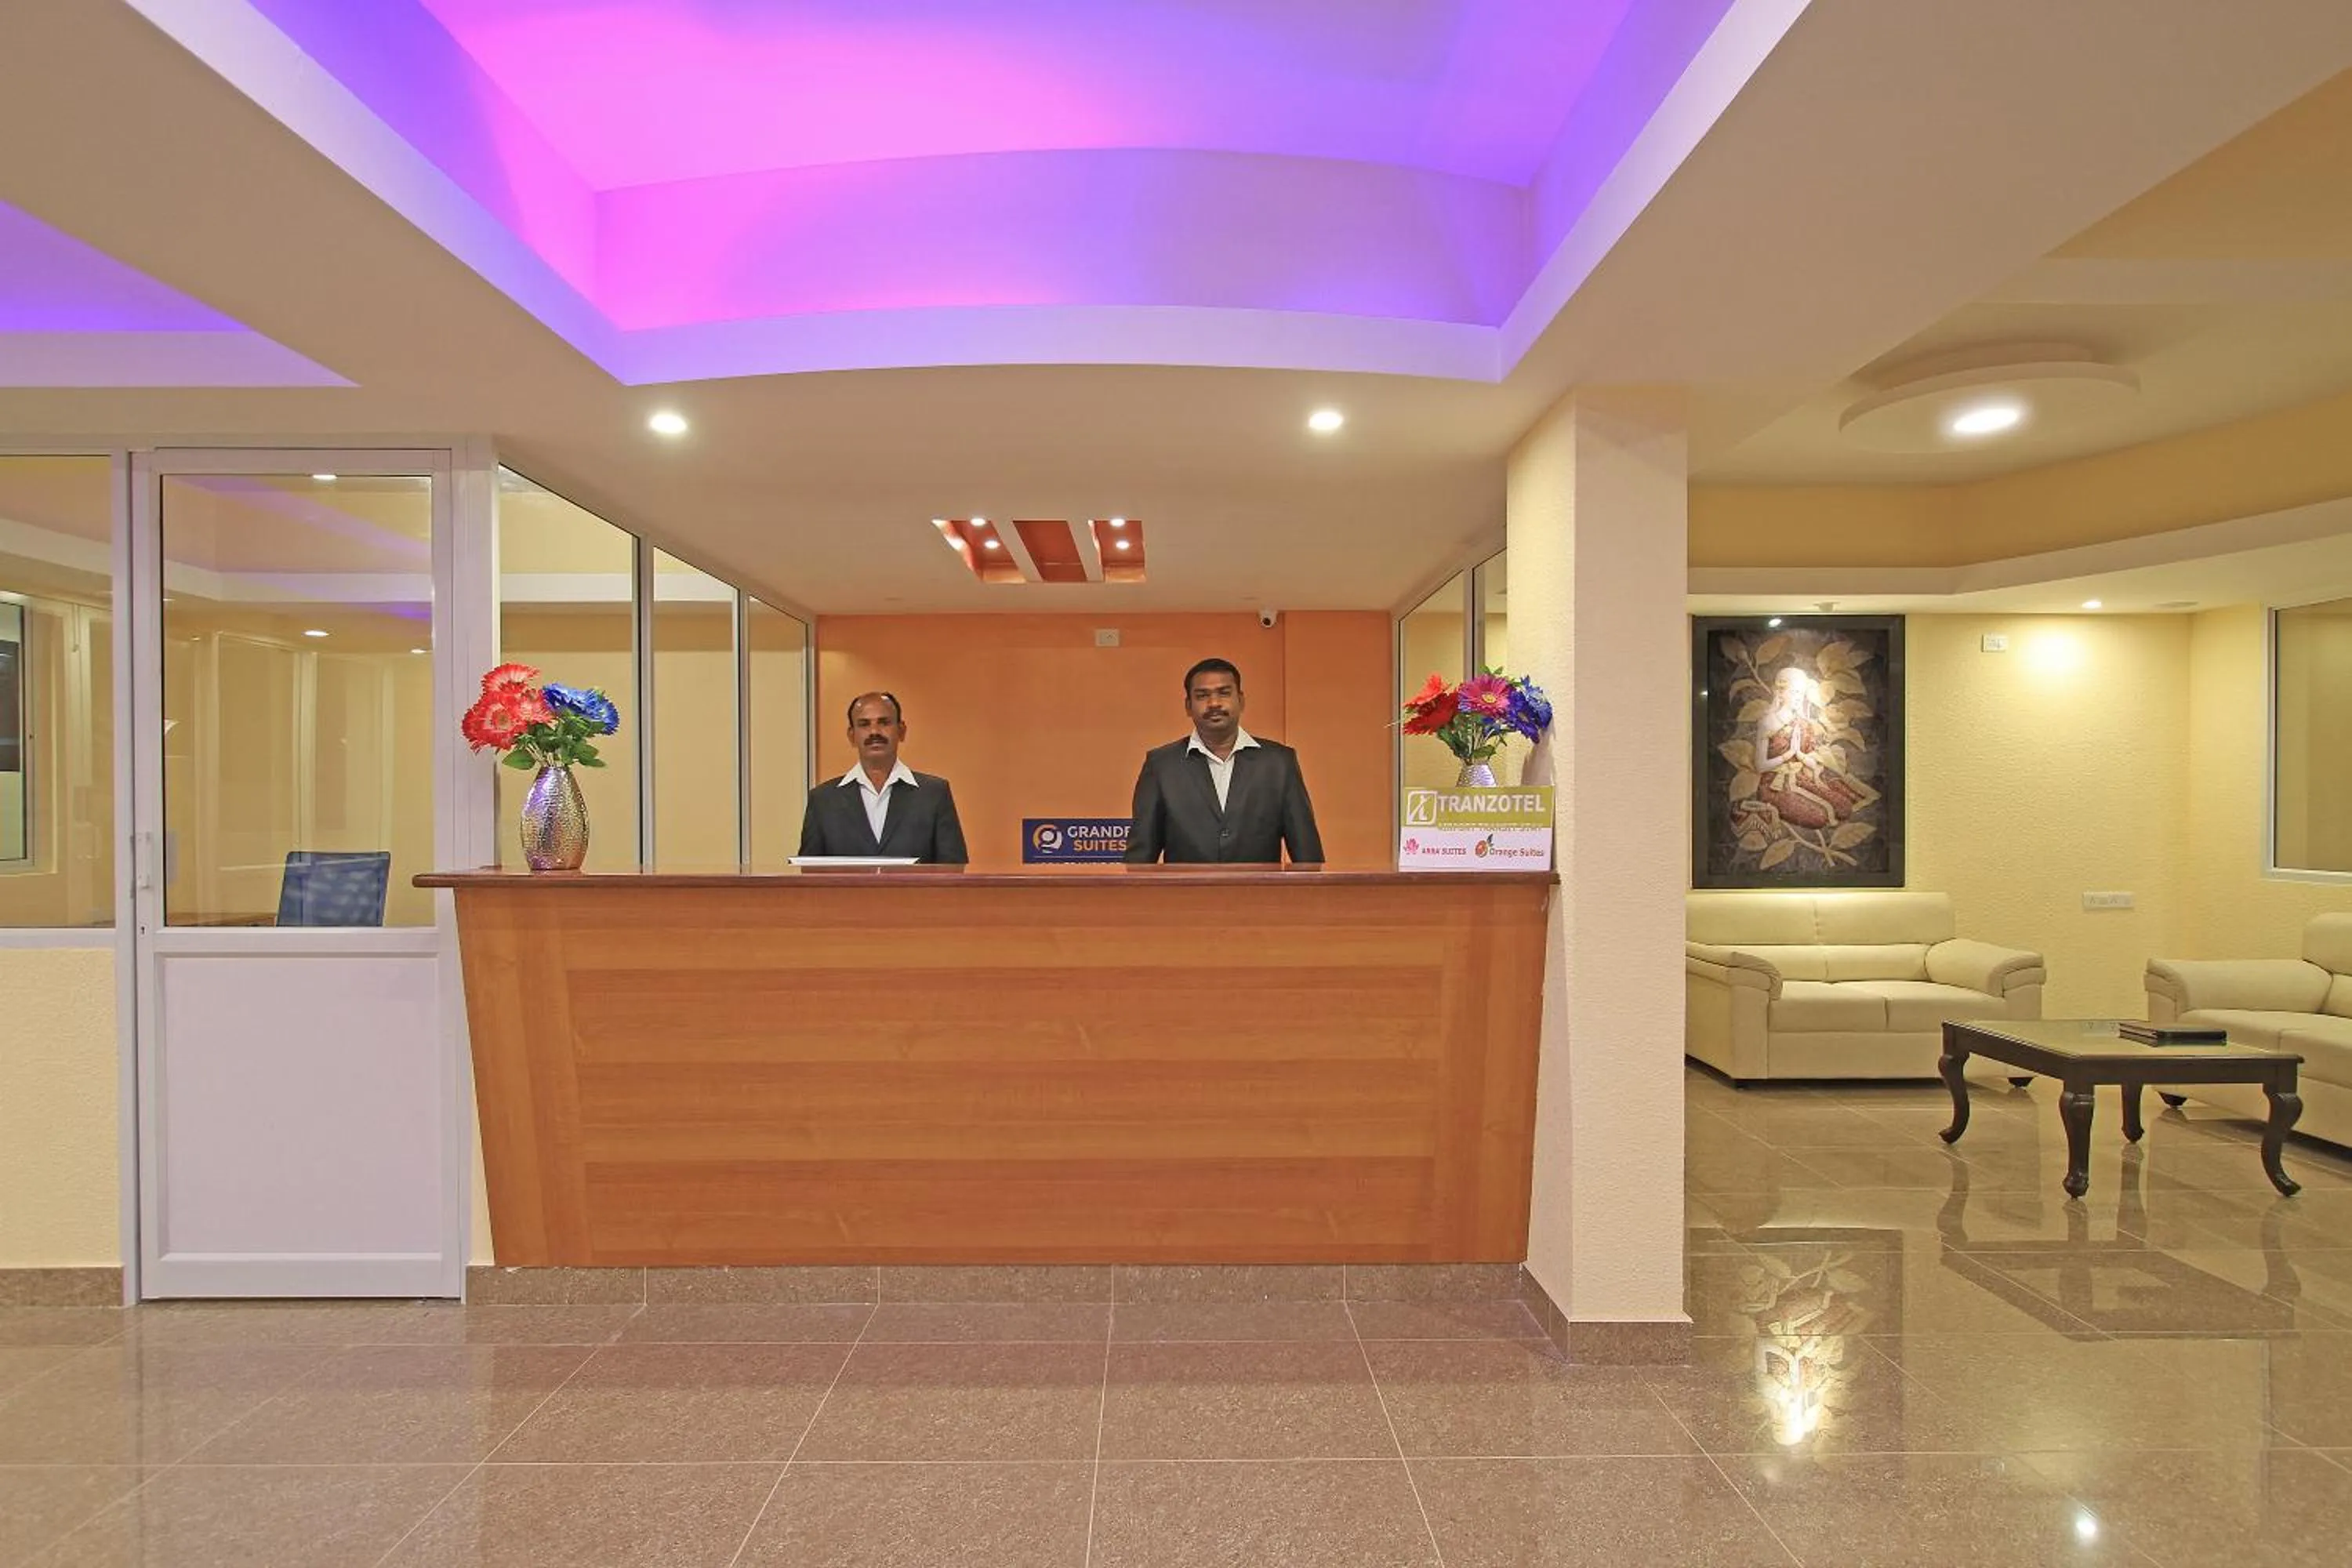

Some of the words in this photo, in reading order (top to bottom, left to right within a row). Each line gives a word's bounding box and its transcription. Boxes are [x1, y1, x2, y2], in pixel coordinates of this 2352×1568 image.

[1438, 794, 1545, 812] TRANZOTEL
[1073, 840, 1127, 851] SUITES
[1490, 848, 1518, 858] Orange
[1520, 848, 1544, 857] Suites
